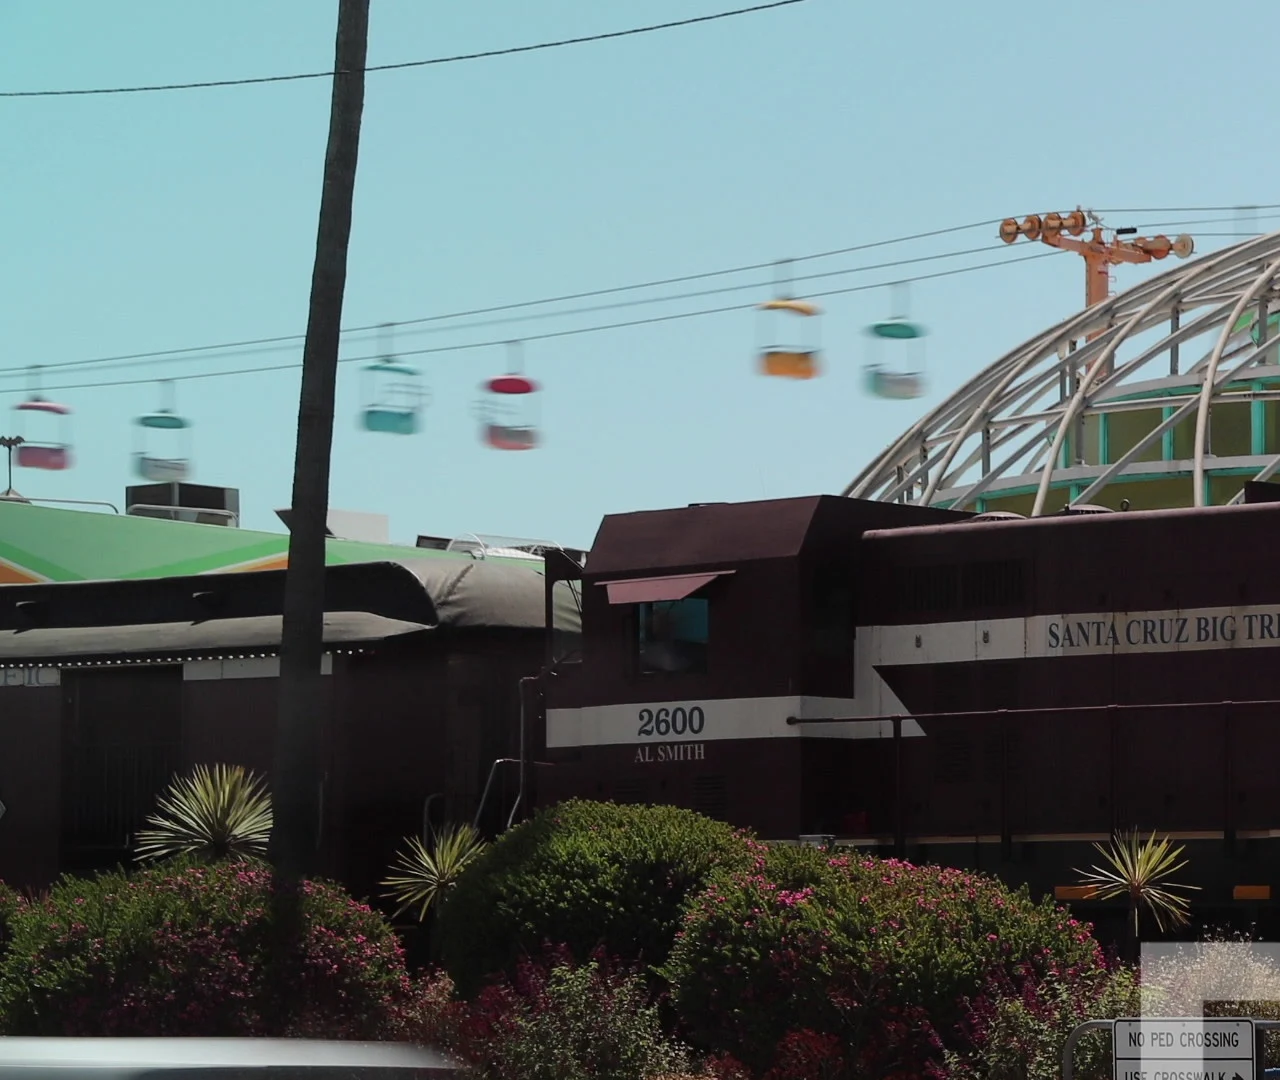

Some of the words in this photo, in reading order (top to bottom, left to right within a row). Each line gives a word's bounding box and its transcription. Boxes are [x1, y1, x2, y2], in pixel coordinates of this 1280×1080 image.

[1048, 619, 1121, 648] SANTA
[1126, 616, 1190, 646] CRUZ
[1196, 614, 1237, 643] BIG
[638, 706, 705, 736] 2600
[634, 746, 654, 763] AL
[657, 743, 705, 762] SMITH
[1128, 1032, 1145, 1047] NO
[1151, 1032, 1174, 1047] PED
[1179, 1031, 1239, 1048] CROSSING
